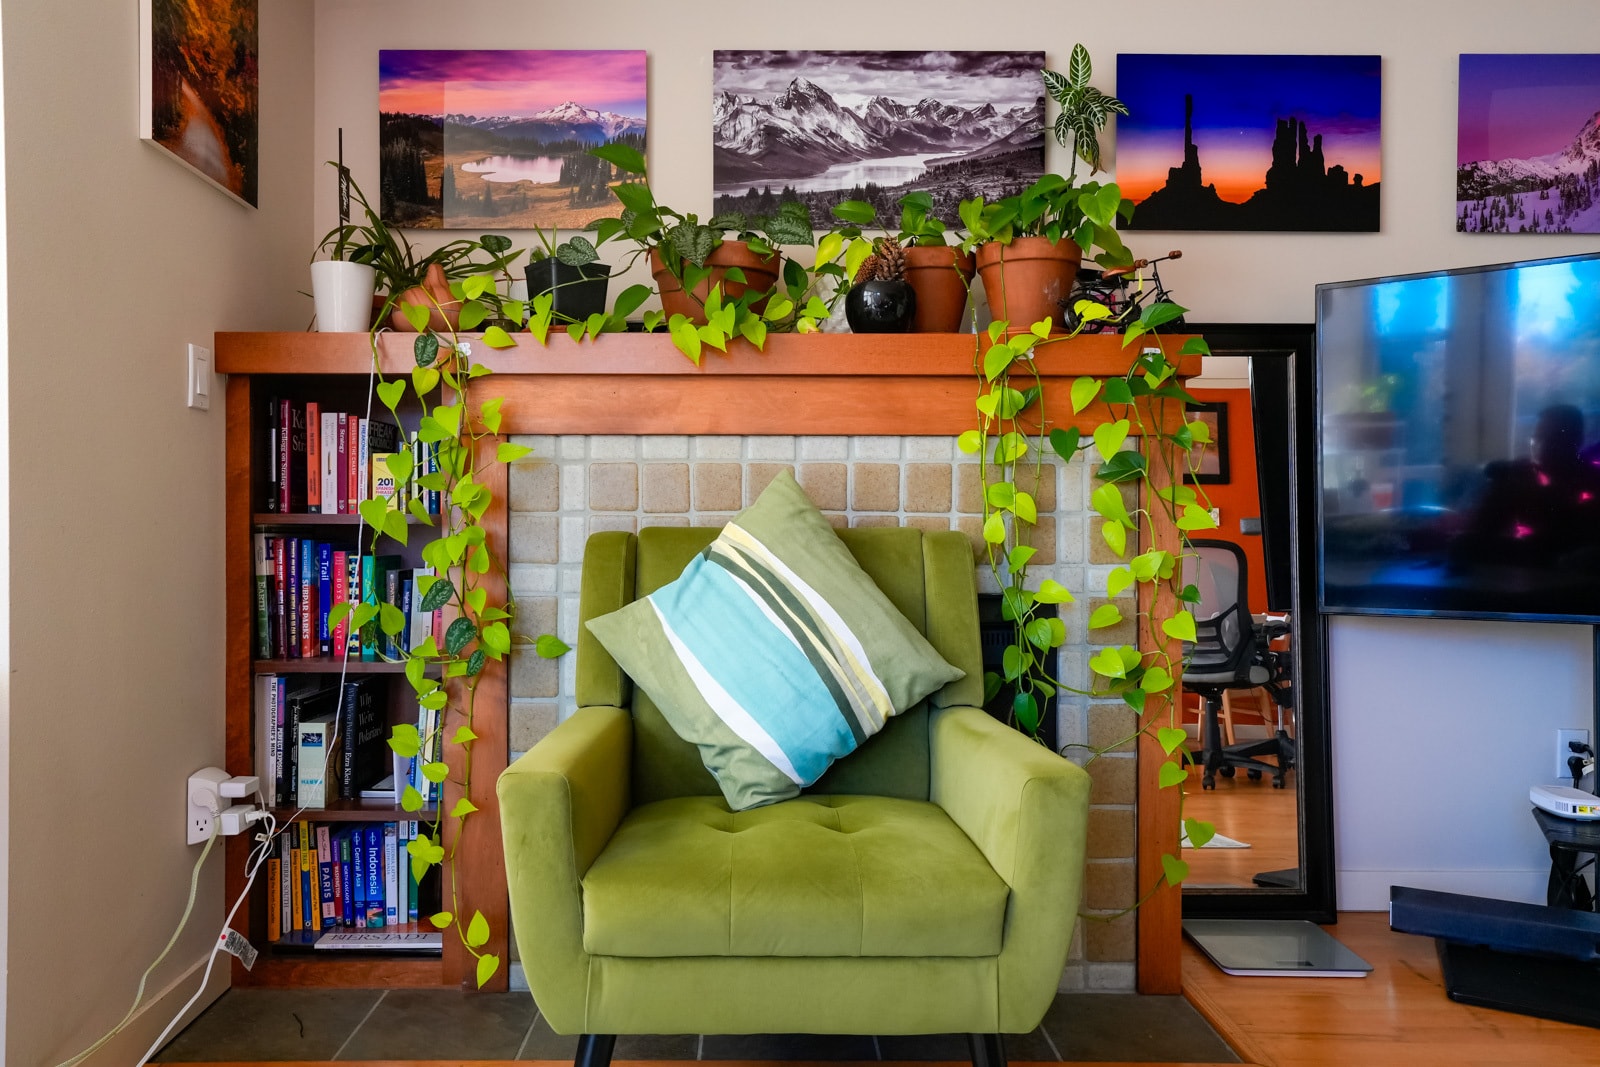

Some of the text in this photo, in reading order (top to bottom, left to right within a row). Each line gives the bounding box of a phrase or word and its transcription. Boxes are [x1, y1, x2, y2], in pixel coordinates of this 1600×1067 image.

[369, 421, 394, 439] FREAK
[377, 478, 394, 486] 201
[322, 868, 332, 898] PARIS
[369, 848, 379, 894] Indonesia
